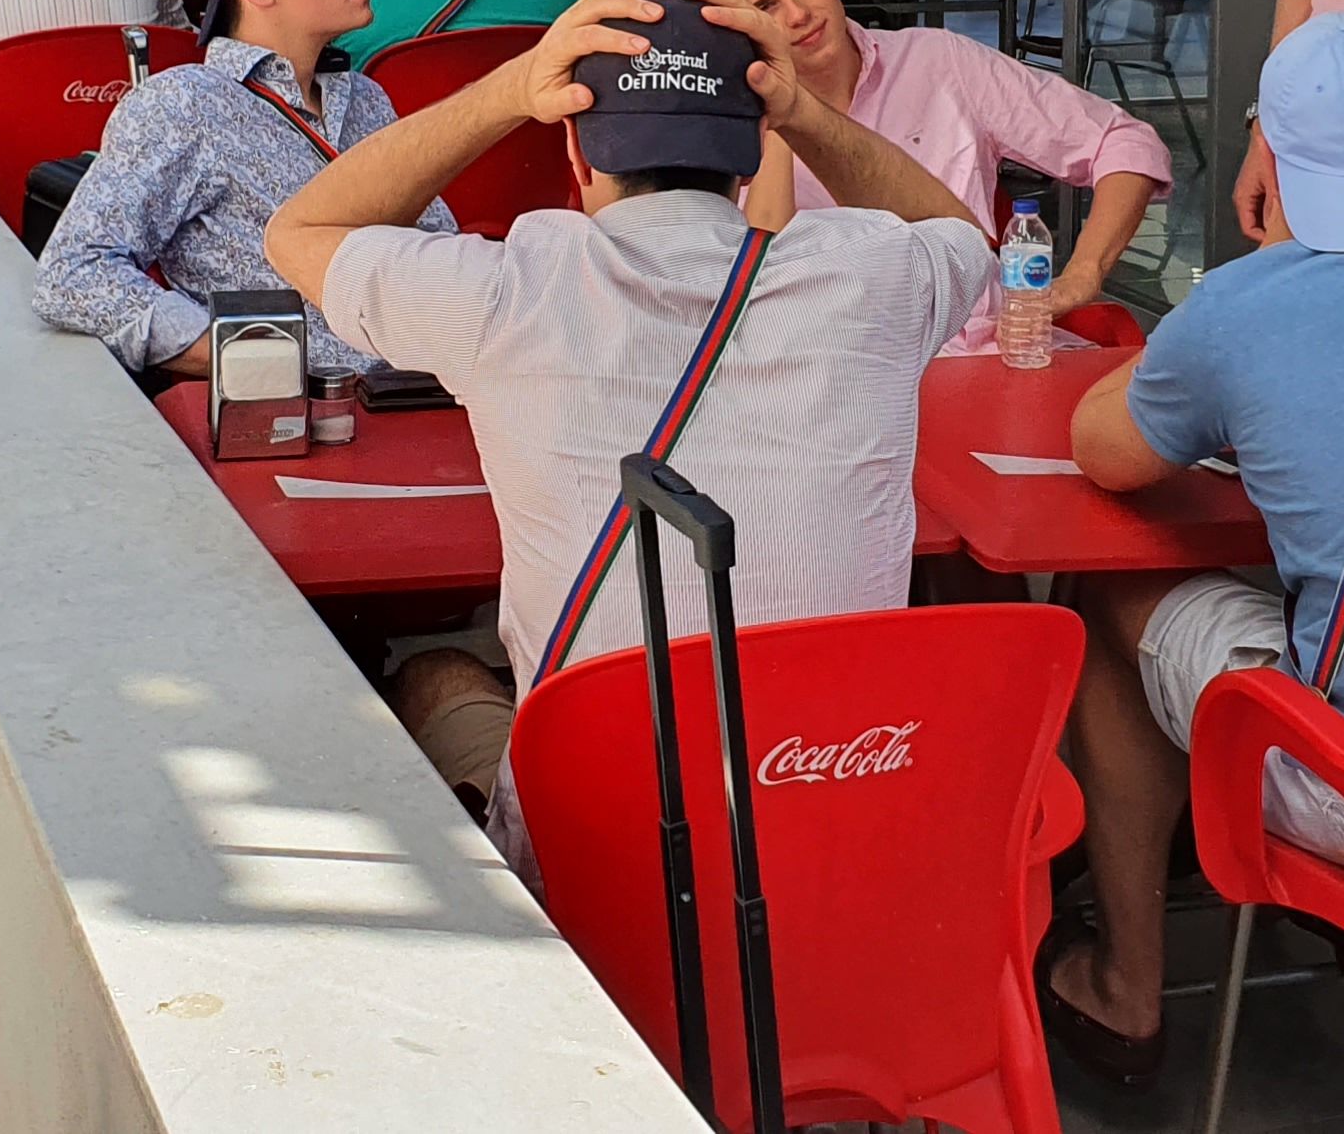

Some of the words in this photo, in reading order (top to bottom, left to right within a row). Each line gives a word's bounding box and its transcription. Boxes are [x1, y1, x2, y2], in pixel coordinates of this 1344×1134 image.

[630, 46, 709, 72] Original
[62, 79, 134, 103] Coca-Col
[756, 720, 923, 786] Coca-Cola
